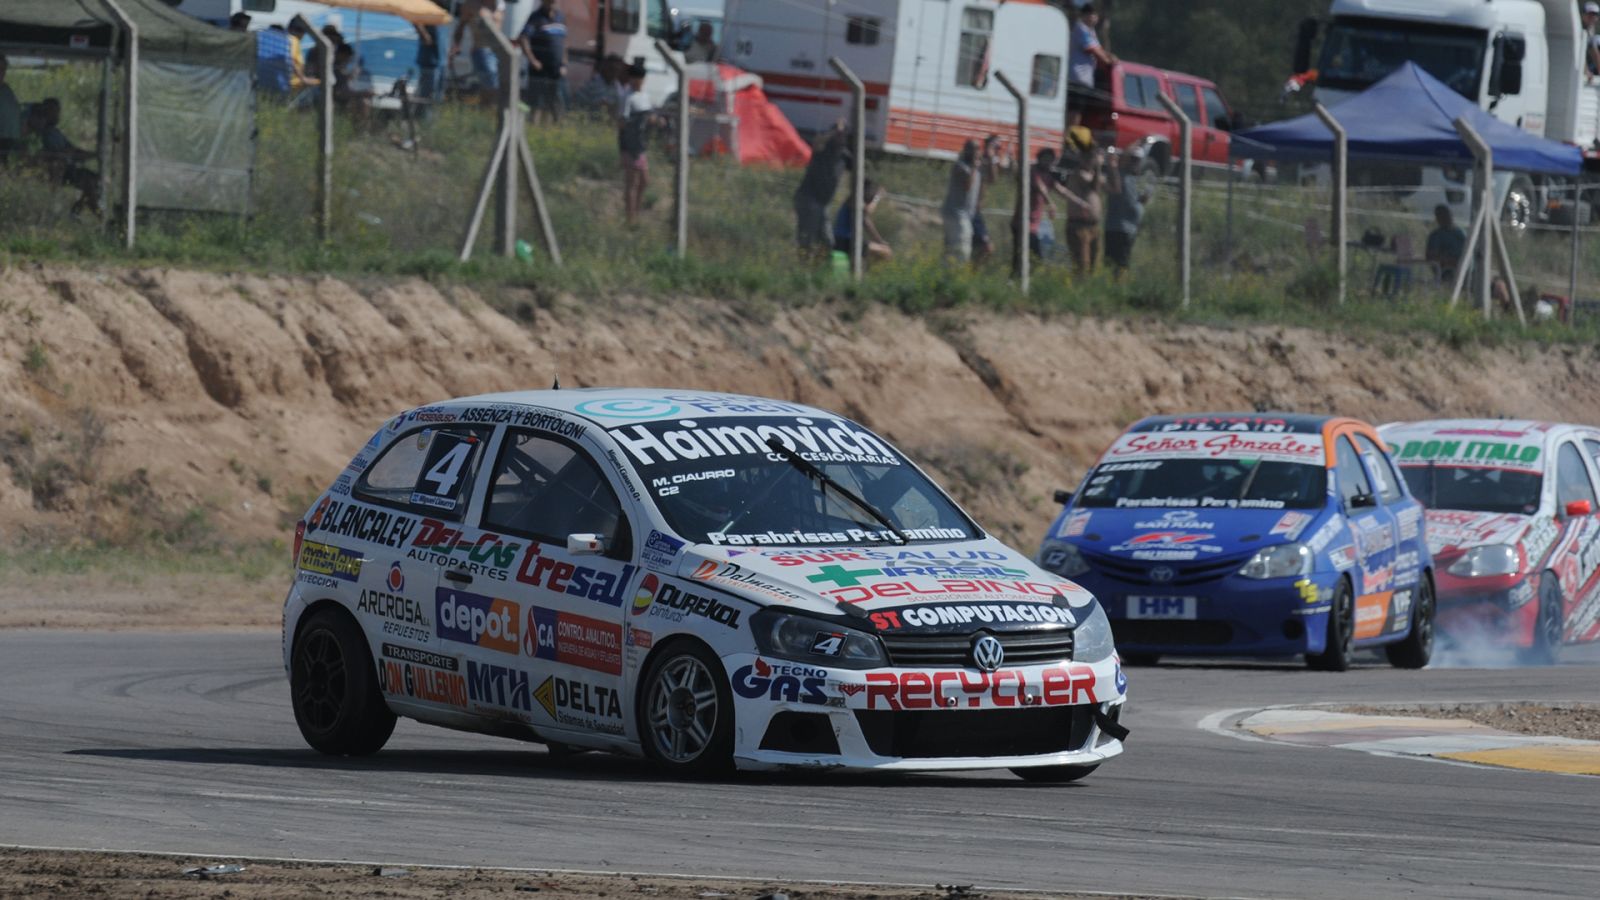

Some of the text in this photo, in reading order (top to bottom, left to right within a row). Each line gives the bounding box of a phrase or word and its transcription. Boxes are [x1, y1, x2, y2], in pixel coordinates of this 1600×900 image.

[461, 407, 512, 425] ASSENZA
[514, 410, 524, 425] Y
[522, 411, 588, 440] BORTOLONI
[608, 418, 893, 465] Haimovich
[1113, 435, 1198, 455] Señor
[1400, 440, 1542, 463] DON ITALO
[425, 442, 472, 496] 4
[766, 451, 901, 466] COCESIONARIAS
[652, 468, 736, 488] M. CIAURRO
[659, 485, 680, 497] C2
[1116, 496, 1198, 508] Parabrisas
[320, 500, 416, 549] BLANCALEY
[707, 530, 849, 546] Parabrisas
[407, 549, 509, 581] AUTOPARTES
[516, 540, 634, 608] tresal
[718, 562, 804, 600] Dalmazzo
[357, 588, 423, 625] ARCROSA
[655, 583, 741, 630] DUREKOL
[868, 602, 1077, 631] ST COMPUTACION
[1139, 598, 1185, 617] HM
[383, 620, 431, 643] REPUESTOS
[538, 623, 555, 649] CA
[558, 621, 585, 641] CONTROL
[386, 645, 453, 669] TRANSPORTE
[814, 636, 842, 657] 4
[379, 658, 468, 708] DON GUILLERMO
[771, 664, 828, 678] TECNO
[466, 660, 532, 711] MTH
[555, 677, 623, 719] DELTA
